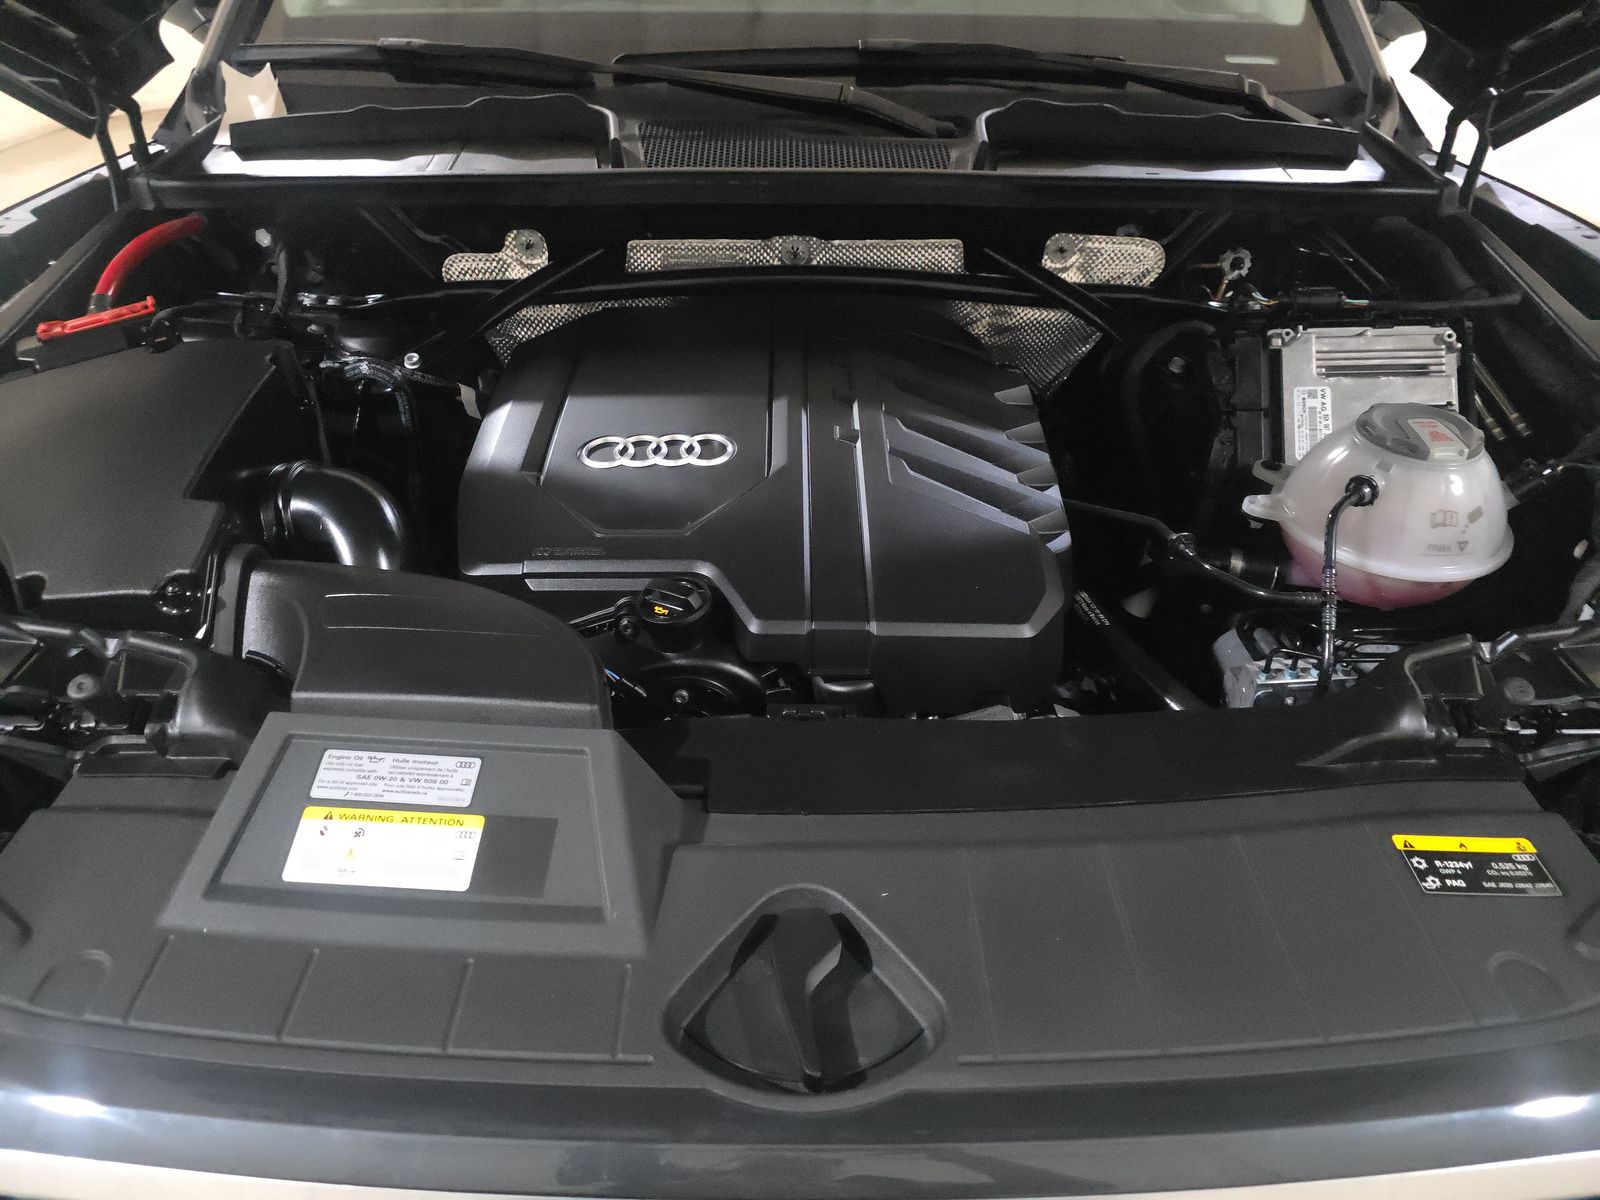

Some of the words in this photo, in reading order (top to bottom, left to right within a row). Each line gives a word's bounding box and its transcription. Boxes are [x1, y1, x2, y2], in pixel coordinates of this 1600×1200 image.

[1320, 388, 1327, 400] VW
[1320, 401, 1327, 412] AG
[339, 813, 394, 823] WARNING
[400, 816, 465, 827] ATTENTION
[1434, 860, 1473, 870] R-1234yf
[1445, 878, 1467, 888] PAG
